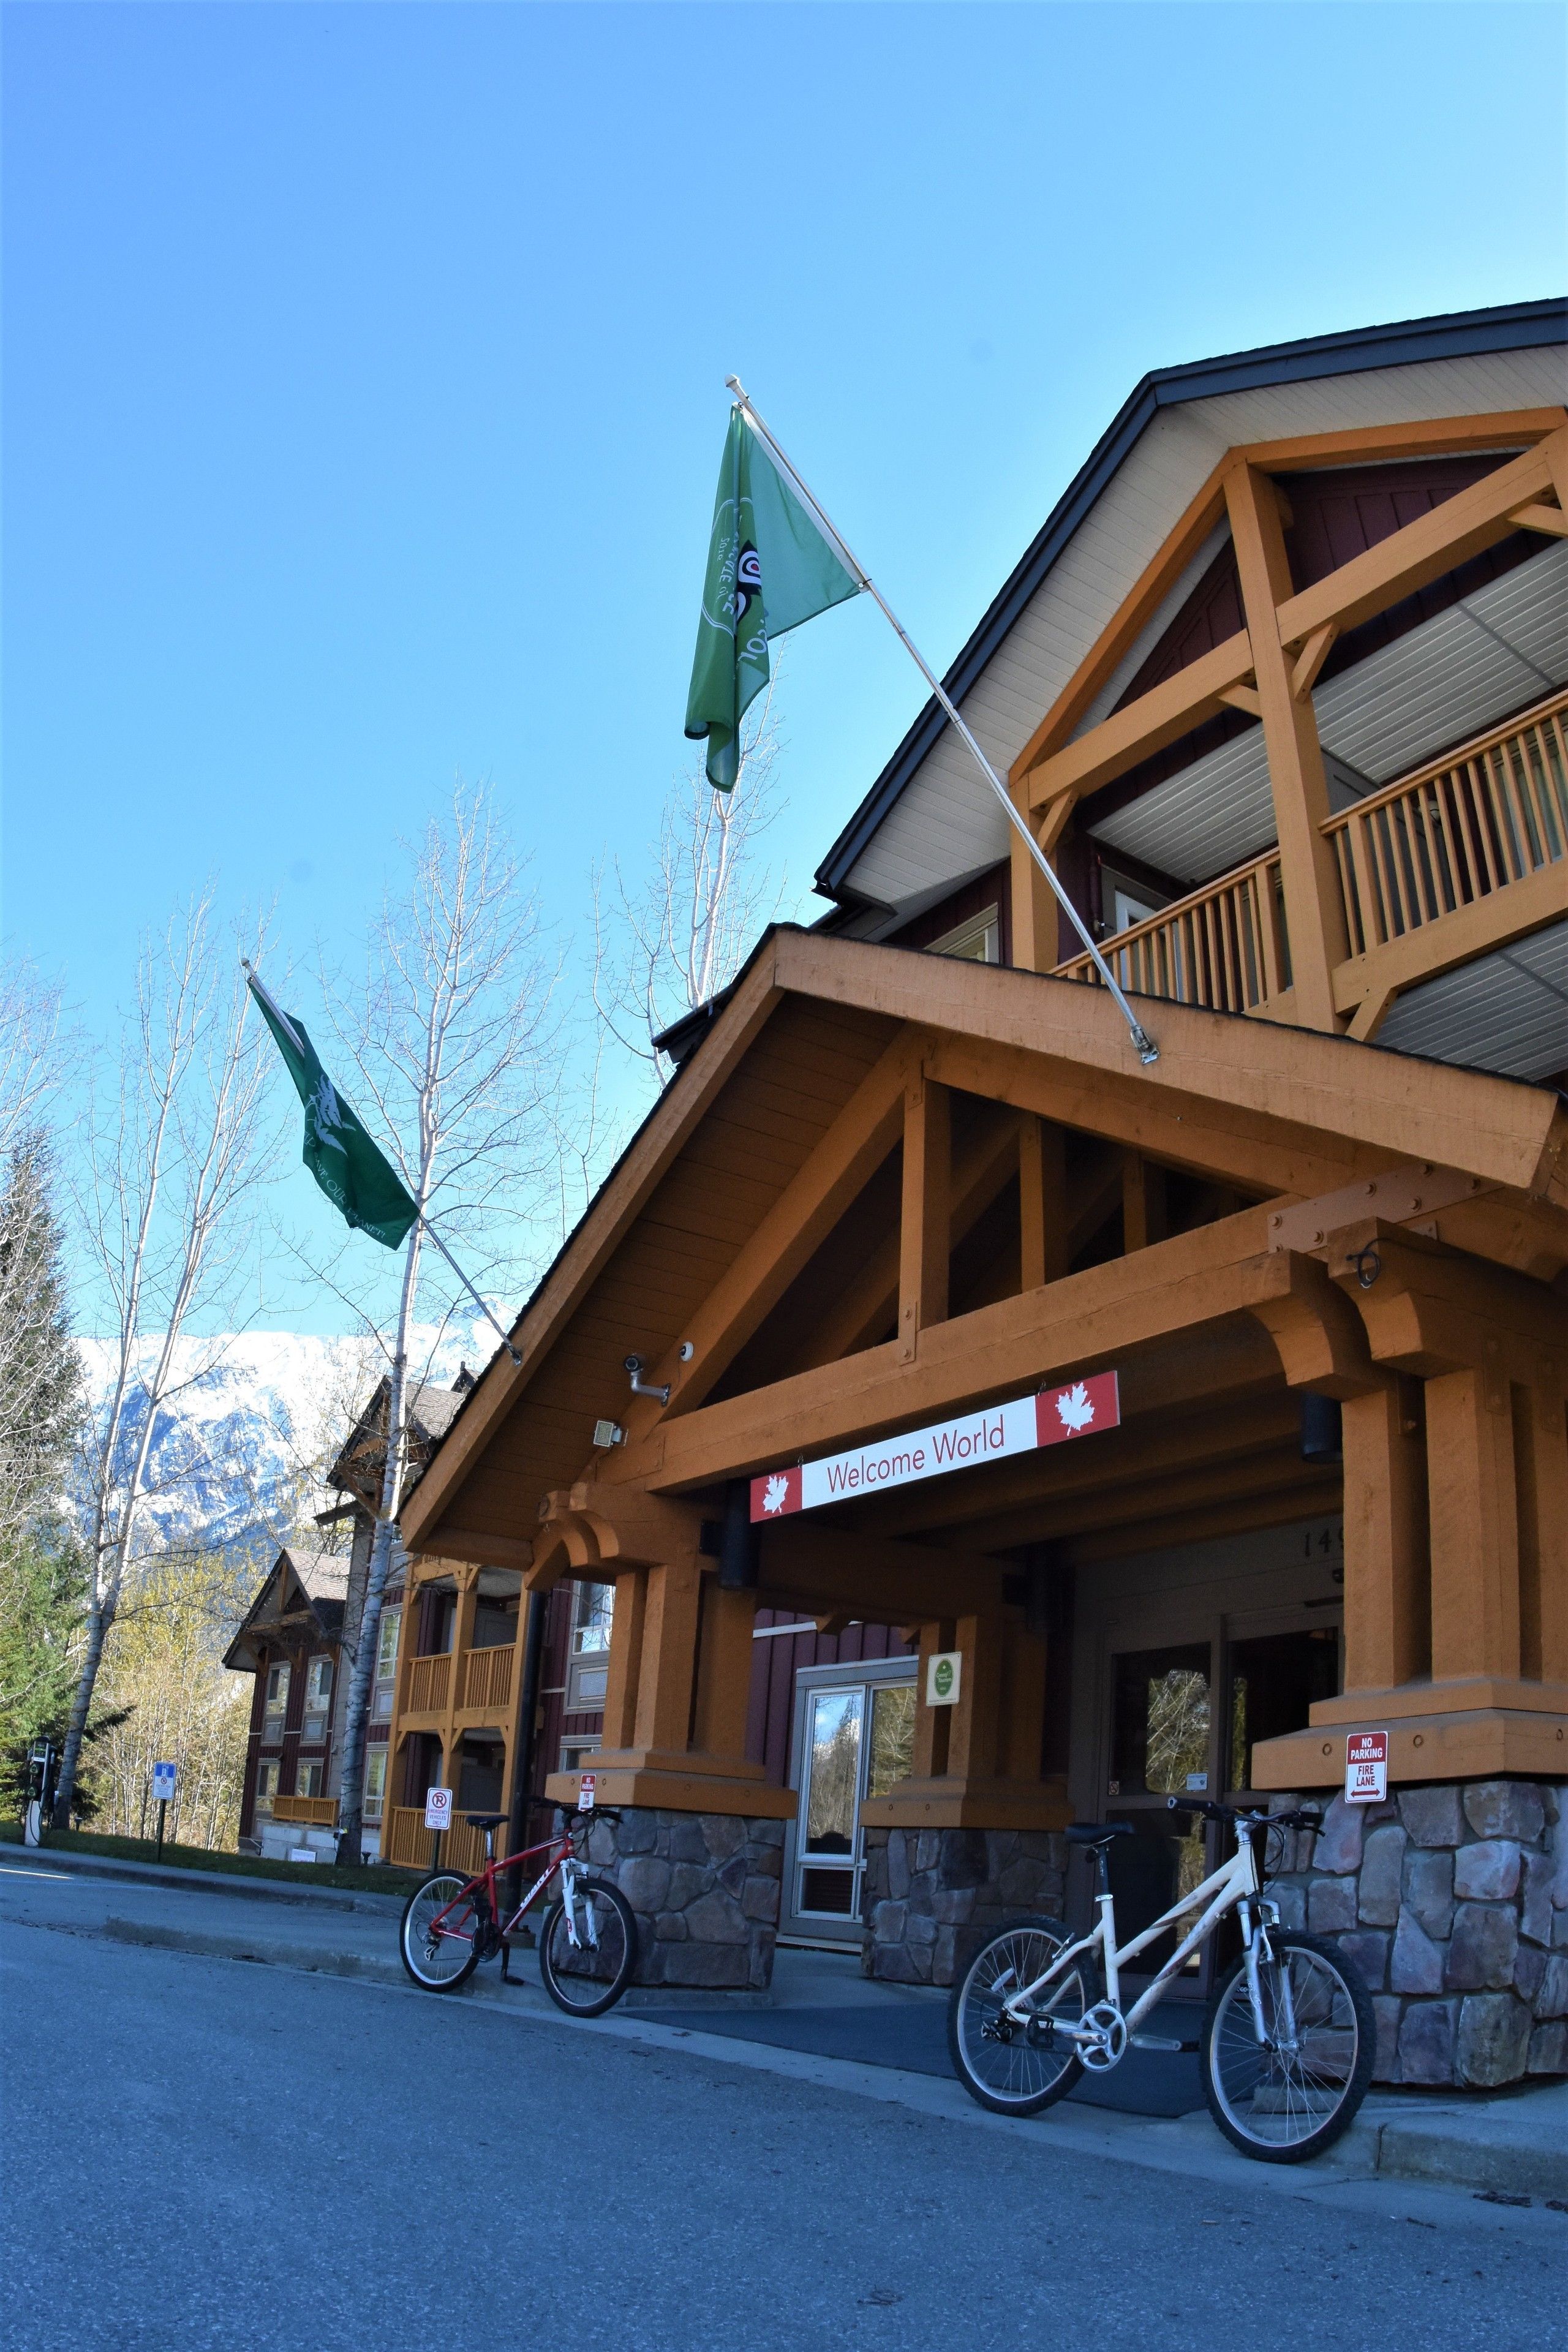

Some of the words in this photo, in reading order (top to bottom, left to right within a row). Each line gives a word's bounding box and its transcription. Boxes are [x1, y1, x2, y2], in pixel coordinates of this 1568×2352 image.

[326, 1180, 347, 1205] OUR
[827, 1449, 925, 1493] Welcome
[932, 1414, 1005, 1464] World
[1362, 1737, 1373, 1748] NO
[1351, 1747, 1383, 1760] PARKING
[1358, 1765, 1374, 1776] FIRE
[1356, 1776, 1376, 1787] LANE
